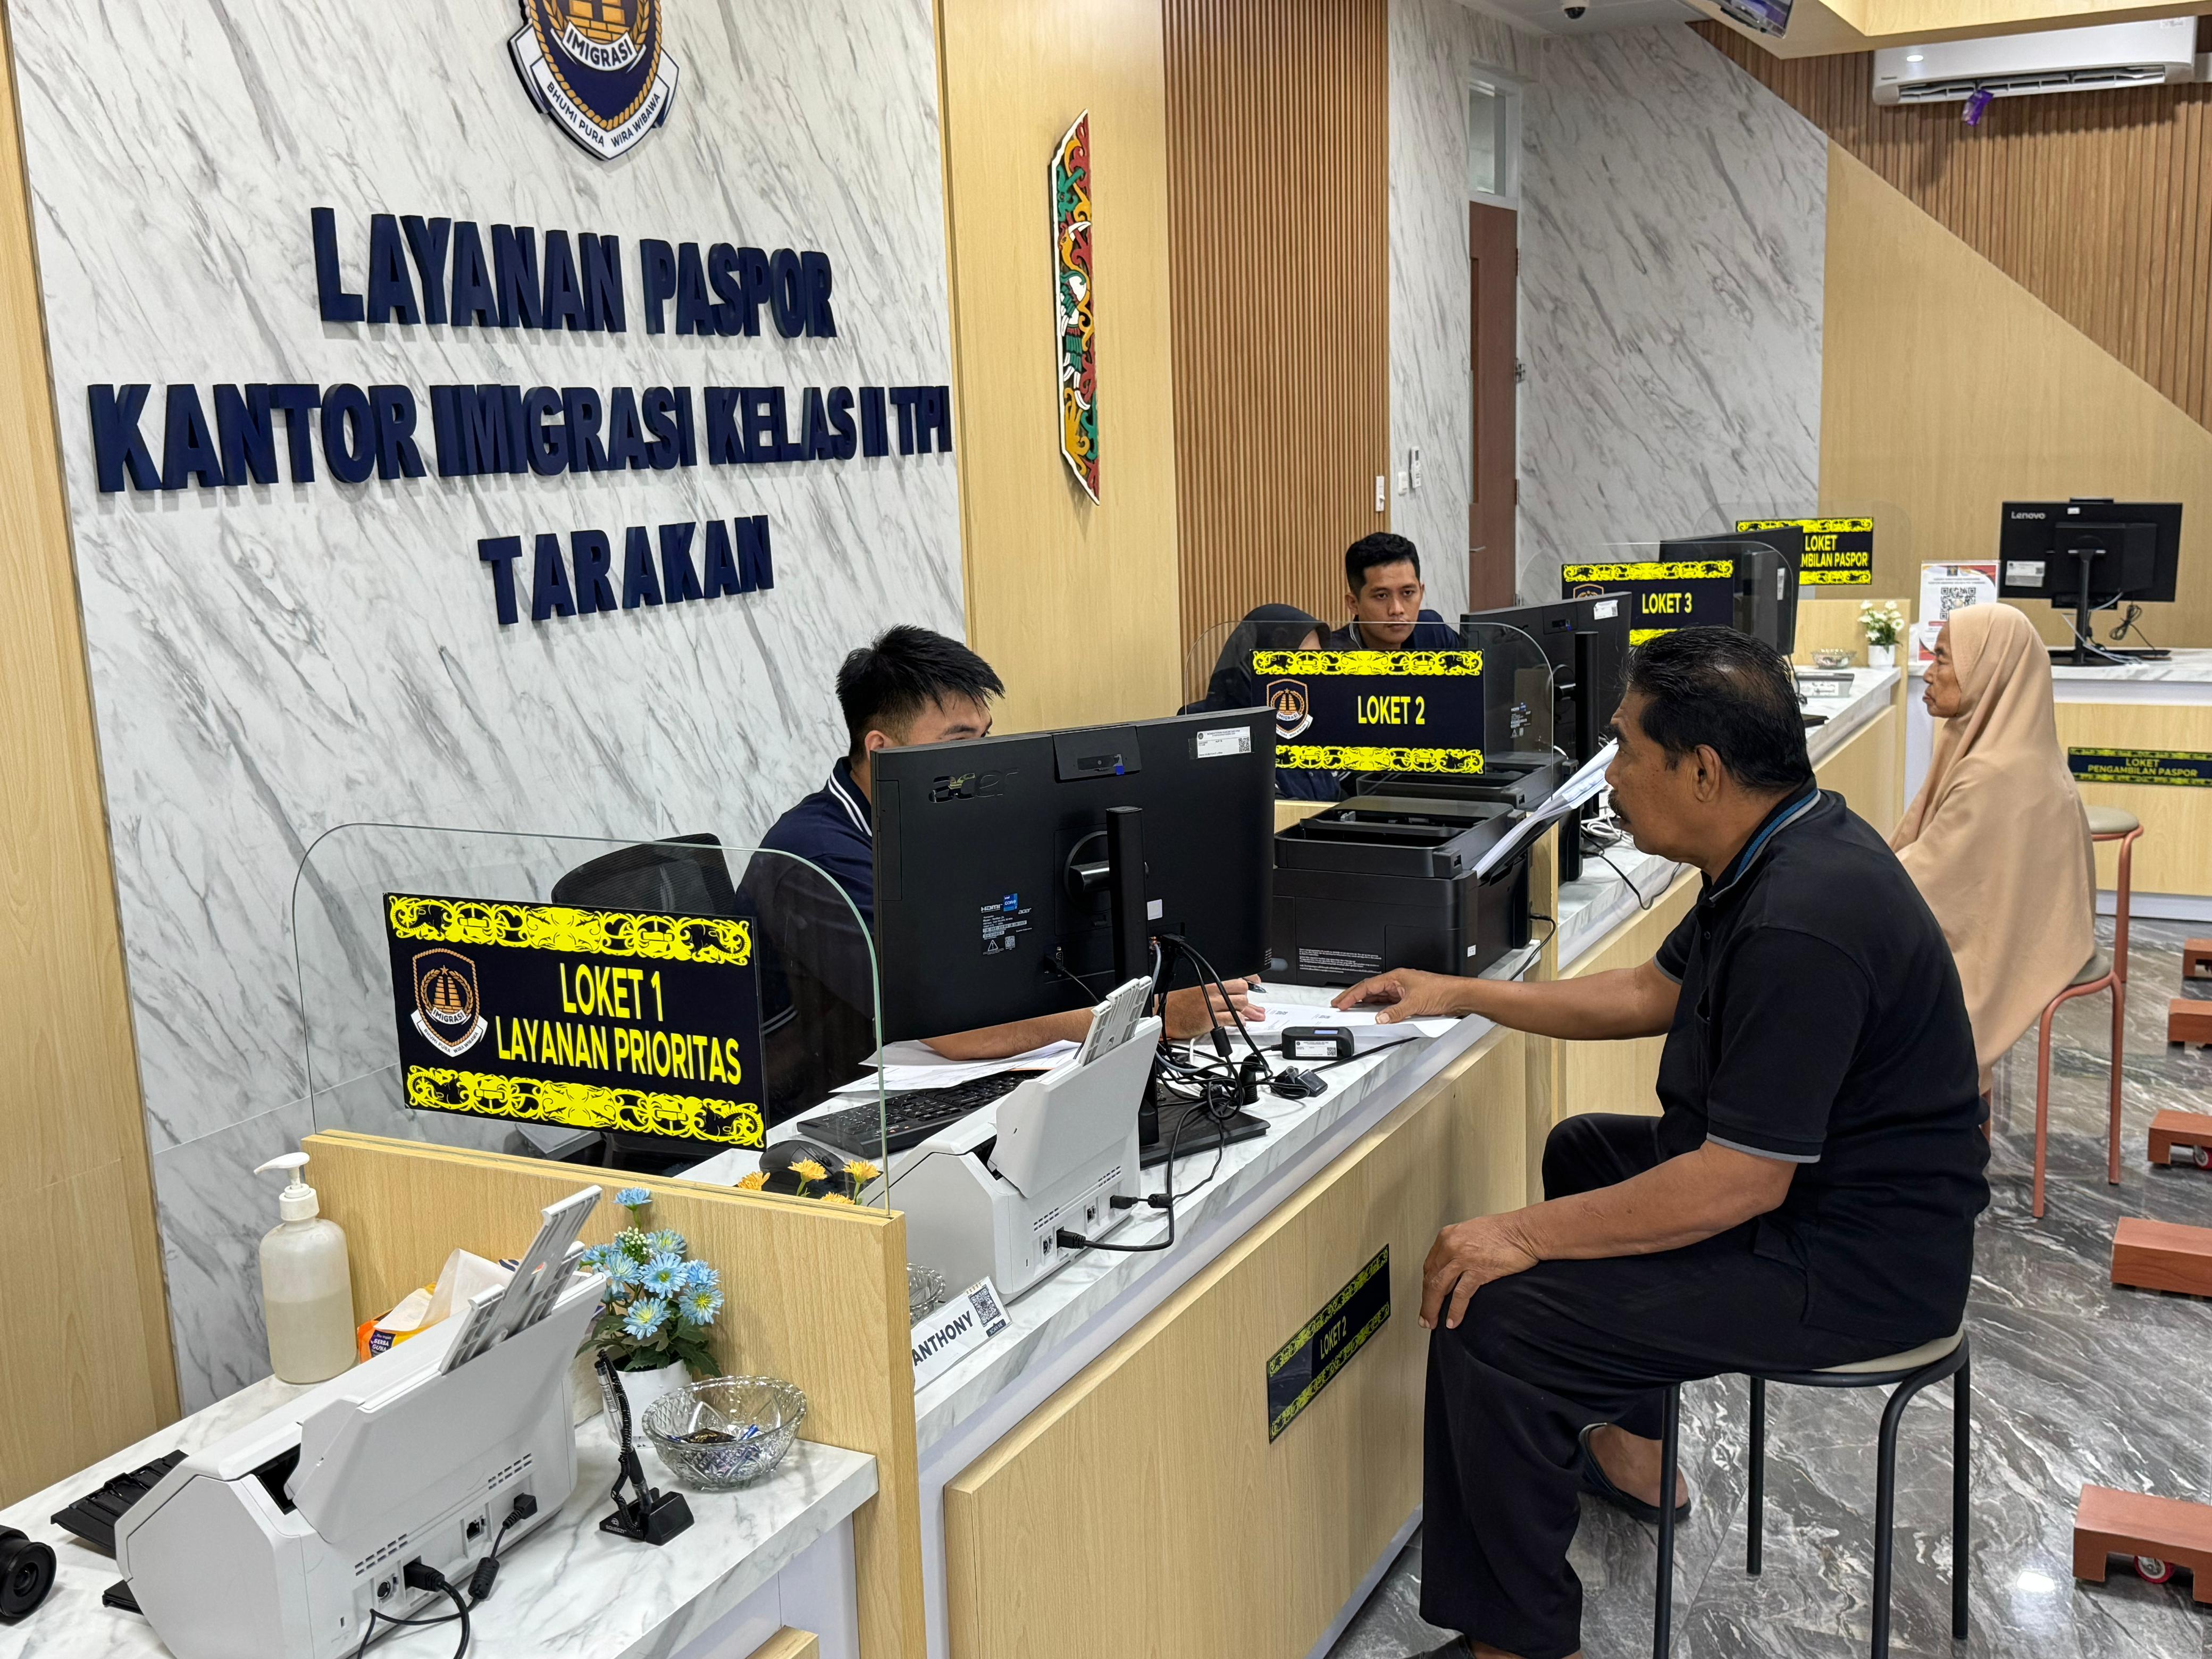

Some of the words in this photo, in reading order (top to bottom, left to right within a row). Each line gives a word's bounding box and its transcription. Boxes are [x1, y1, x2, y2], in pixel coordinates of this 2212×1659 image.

[566, 28, 633, 67] IMIGRASI
[547, 82, 577, 123] BHUMI
[579, 120, 605, 147] PURA
[610, 128, 634, 147] WIRA
[632, 93, 660, 131] WIBAWA
[311, 206, 626, 333] LAYANAN
[640, 238, 837, 338] PASPOR
[87, 383, 426, 493] KANTOR
[429, 383, 697, 477] IMIGRASI
[702, 386, 858, 465] KELAS
[858, 386, 889, 457] II
[889, 386, 952, 454] TPI
[2011, 511, 2046, 520] Lenovo
[1800, 552, 1833, 567] MBILAN
[1834, 551, 1869, 567] PASPOR
[1805, 534, 1838, 551] LOKET
[478, 515, 774, 626] TARAKAN
[1642, 593, 1682, 614] LOKET
[1684, 593, 1692, 613] 3
[1358, 696, 1411, 725] LOKET
[1415, 696, 1425, 725] 2
[2088, 764, 2156, 776] PENGAMBILAN
[2158, 768, 2198, 777] PASPOR
[2126, 757, 2160, 768] LOKET
[928, 767, 1019, 803] acer
[560, 962, 643, 1019] LOKET
[651, 970, 663, 1021] 1
[433, 1010, 465, 1023] IMIGRASI
[495, 1016, 609, 1071] LAYANAN
[615, 1027, 742, 1085] PRIORITAS
[911, 1310, 973, 1367] ANTHONY
[1321, 1321, 1341, 1360] LOKET
[1342, 1316, 1347, 1337] 2
